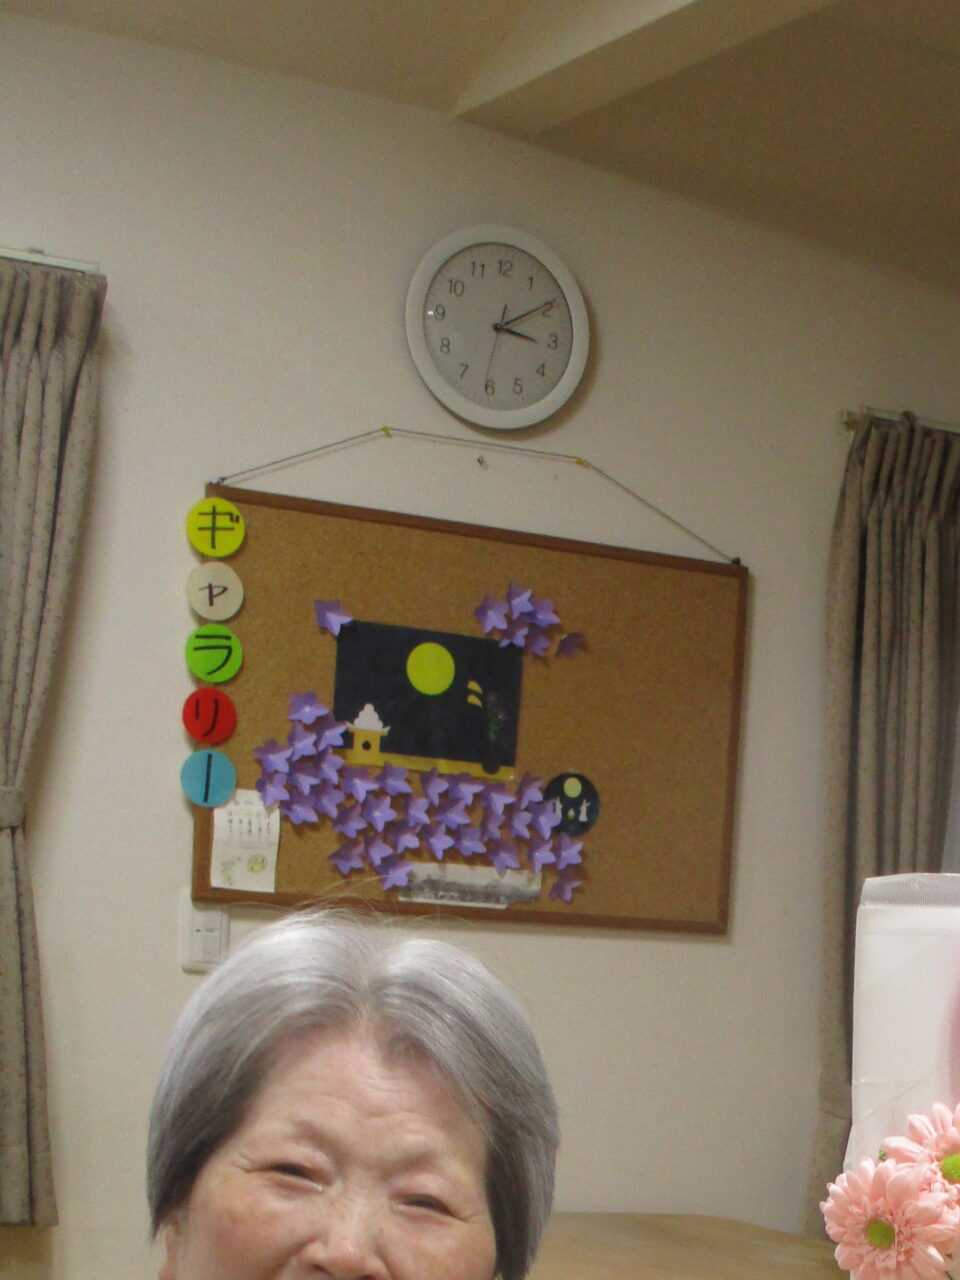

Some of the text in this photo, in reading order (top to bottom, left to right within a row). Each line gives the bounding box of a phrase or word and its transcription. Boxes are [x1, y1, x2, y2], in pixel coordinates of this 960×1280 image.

[471, 260, 485, 278] 11
[498, 259, 514, 279] 12
[448, 279, 465, 297] 10
[434, 304, 446, 320] 9
[440, 338, 450, 354] 8
[547, 333, 558, 350] 3
[459, 363, 469, 380] 7
[536, 362, 546, 378] 4
[484, 379, 495, 396] 6
[512, 378, 523, 394] 5
